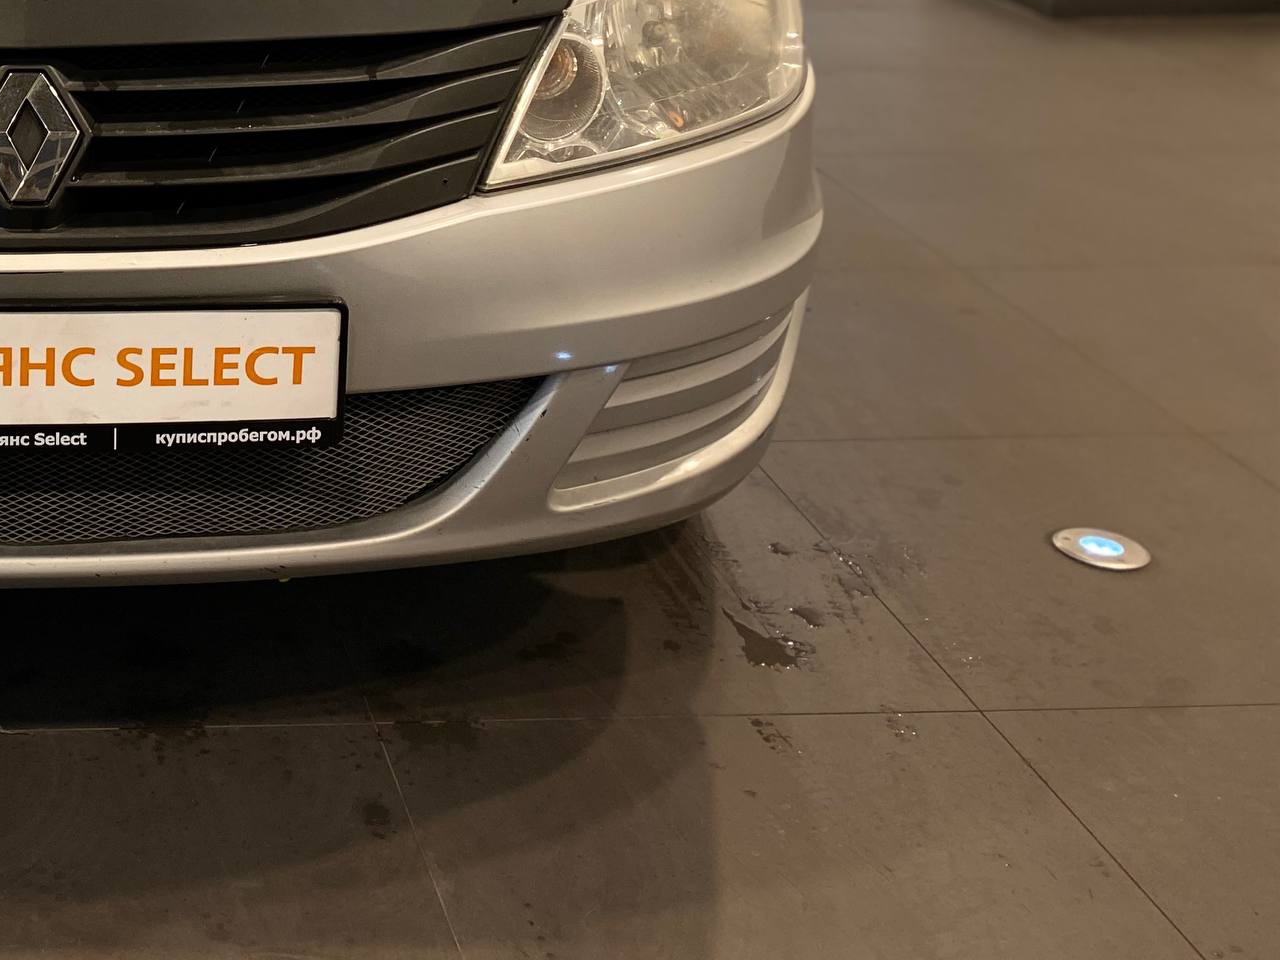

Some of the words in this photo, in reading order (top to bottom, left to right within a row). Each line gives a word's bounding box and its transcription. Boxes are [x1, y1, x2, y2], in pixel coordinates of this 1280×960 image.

[116, 345, 316, 388] SELECT
[35, 431, 88, 447] Select
[155, 427, 322, 448] куписпробегом.рф
